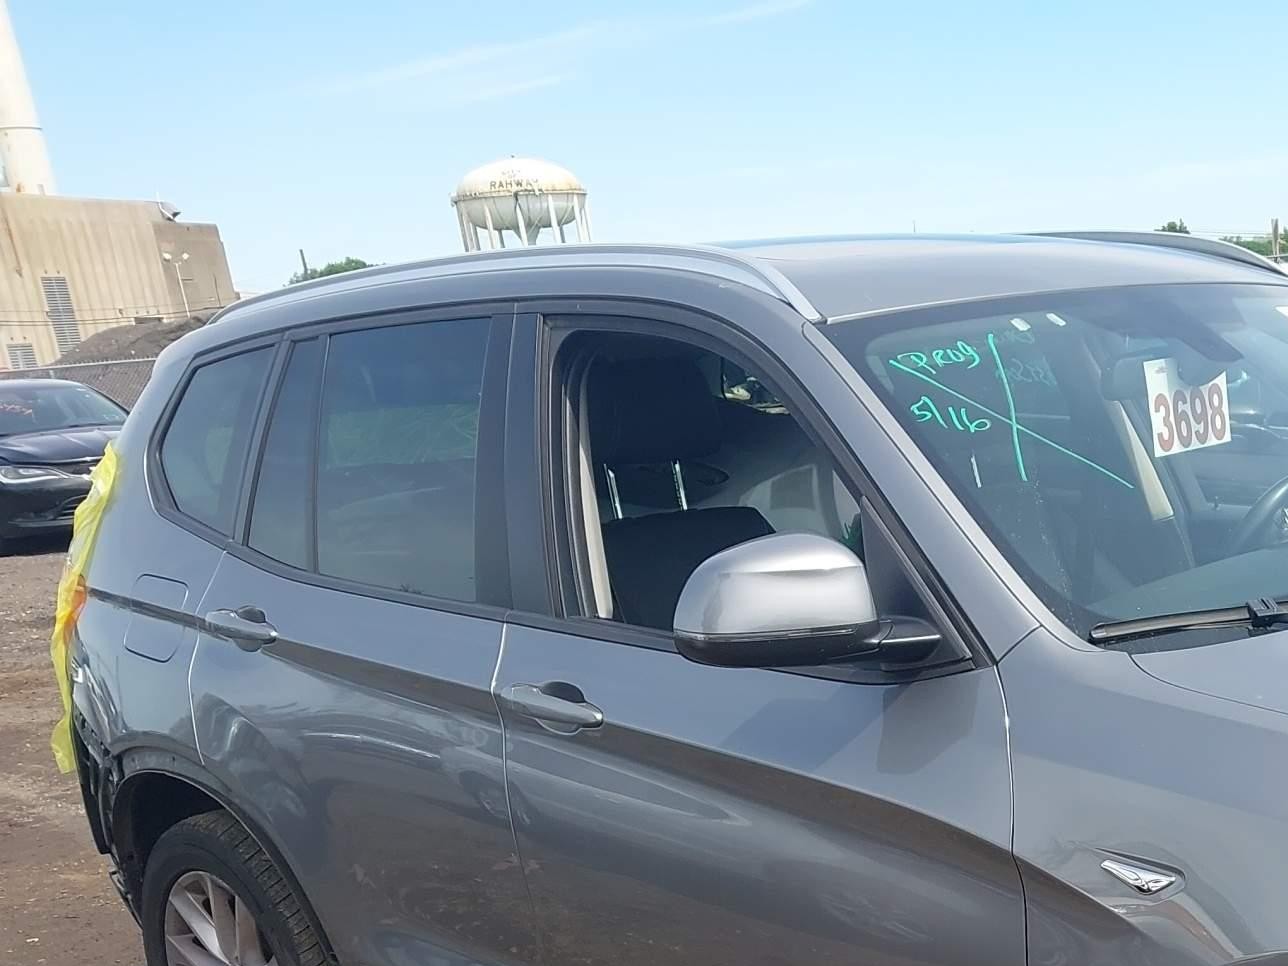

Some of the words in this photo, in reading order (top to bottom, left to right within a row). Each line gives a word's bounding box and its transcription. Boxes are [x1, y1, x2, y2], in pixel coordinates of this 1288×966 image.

[489, 179, 539, 190] RAHWAY
[910, 395, 992, 433] 5/16
[1154, 383, 1227, 452] 3698
